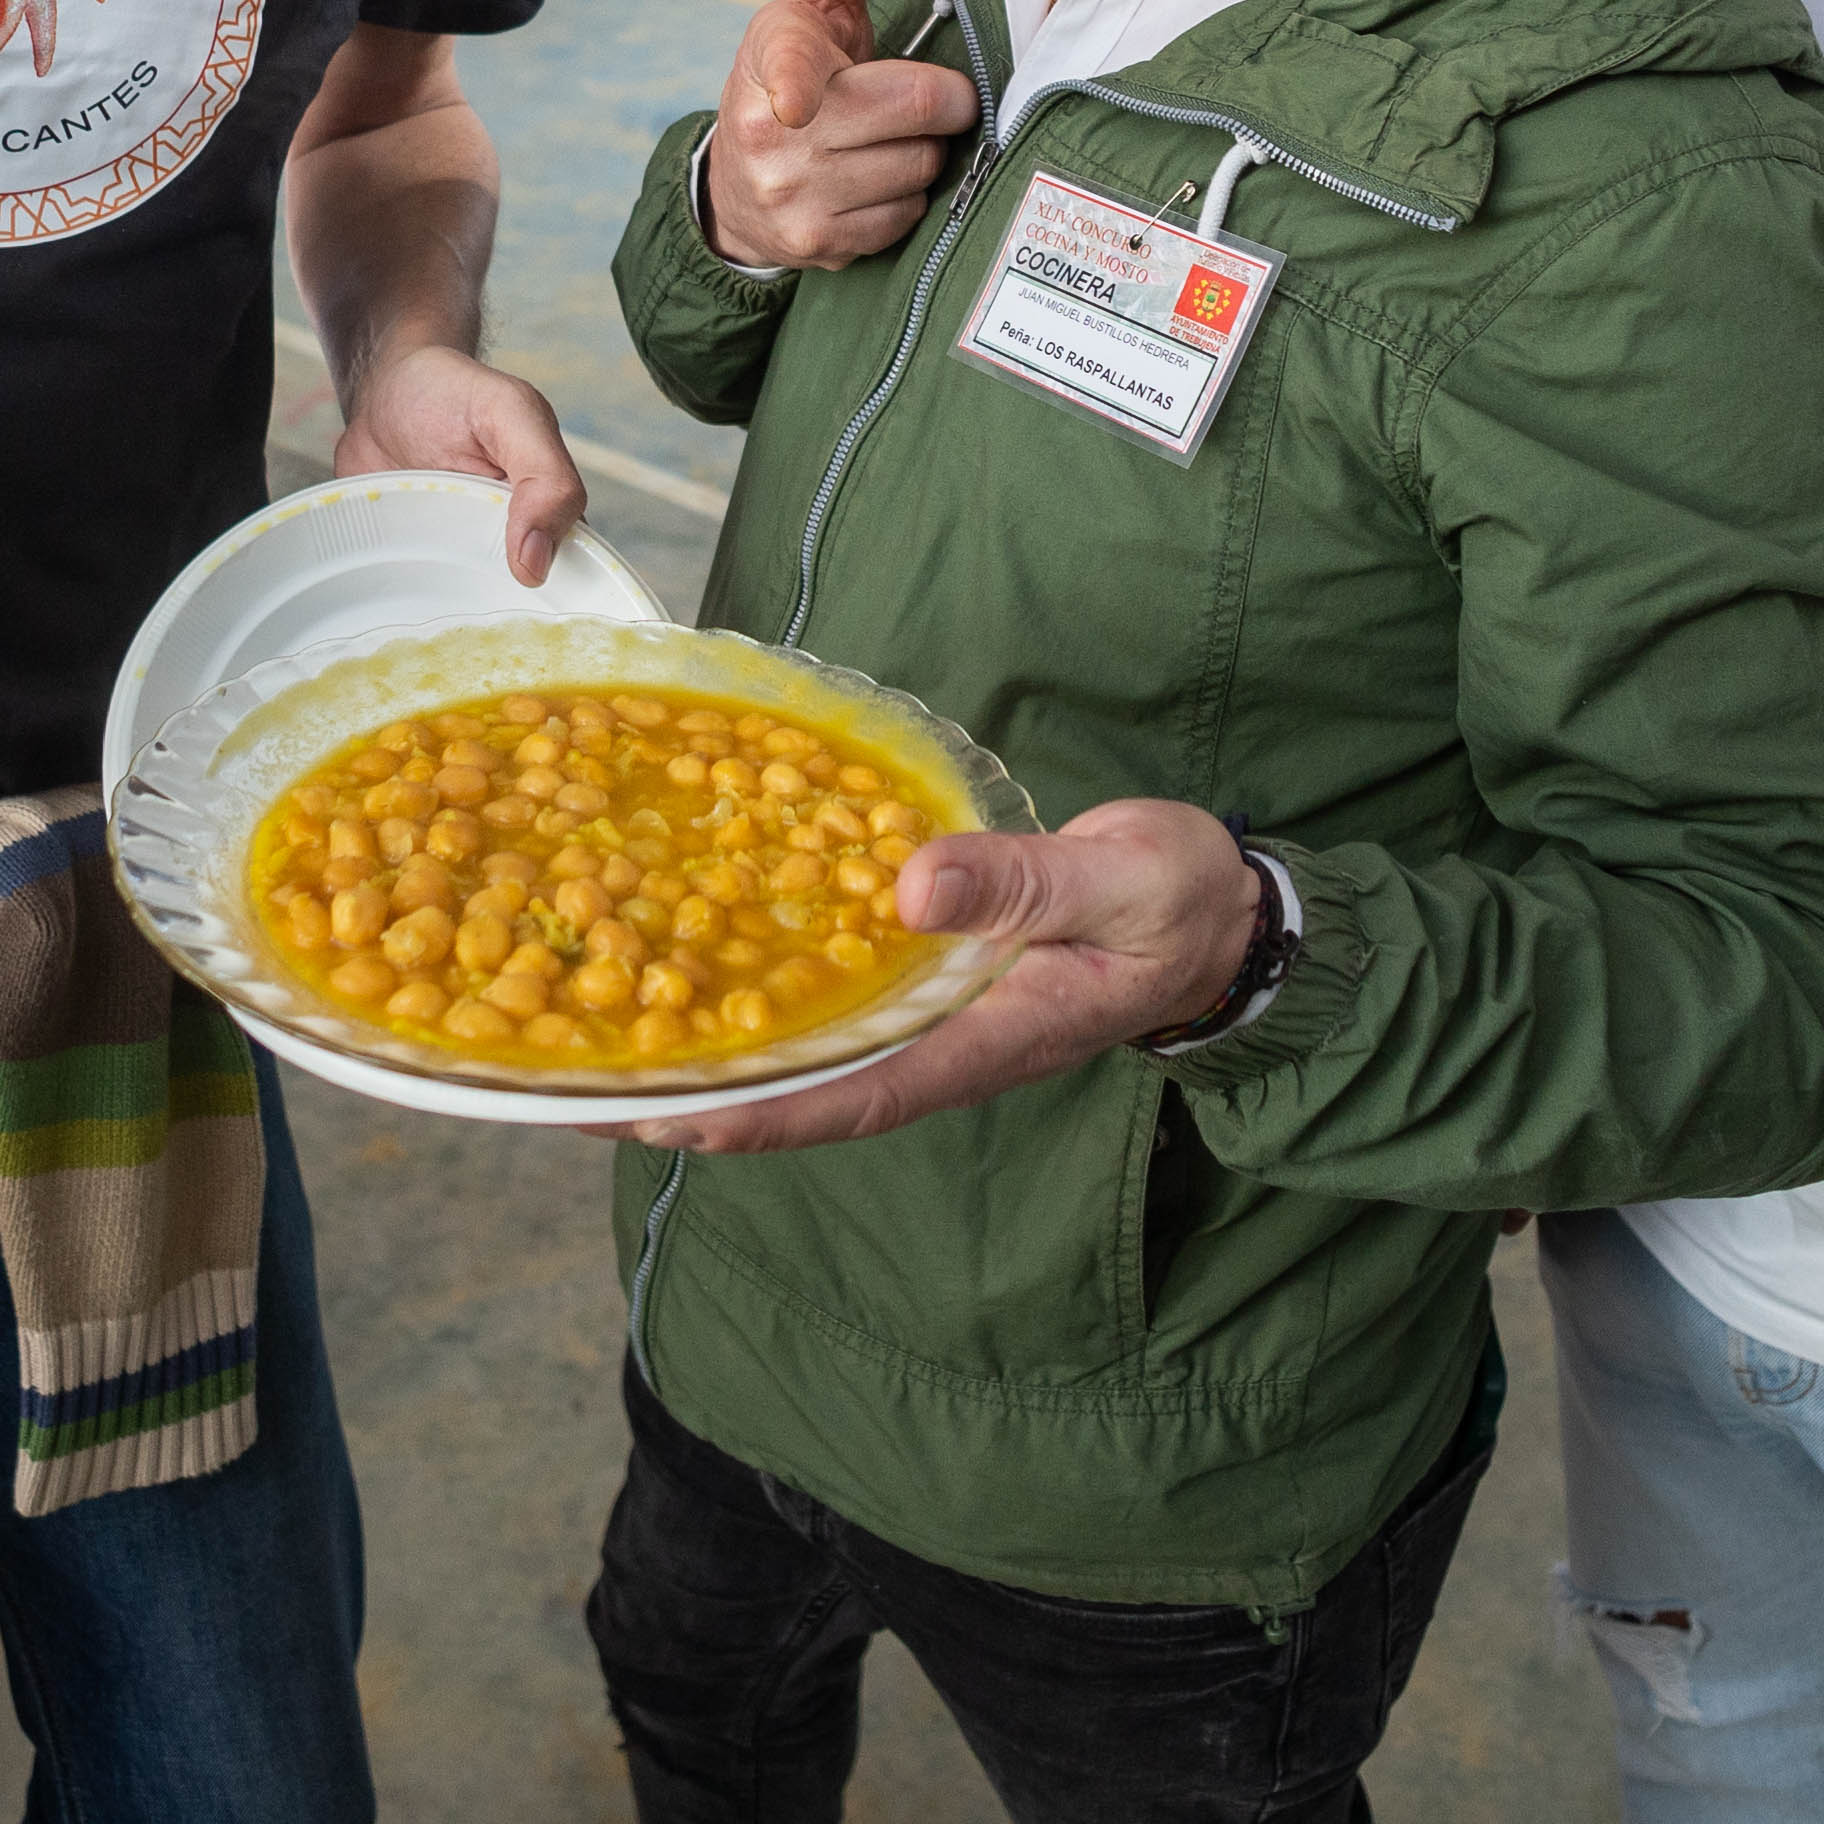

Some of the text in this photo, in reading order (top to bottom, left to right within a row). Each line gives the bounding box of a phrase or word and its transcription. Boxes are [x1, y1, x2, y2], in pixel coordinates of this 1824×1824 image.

[1034, 201, 1070, 225] XLIV
[1015, 246, 1117, 304] COCINERA
[1025, 222, 1149, 284] COCINA Y MOSTO
[1018, 287, 1190, 371] JUAN MIGUEL BUSTILLOS HEDRERA
[1168, 326, 1221, 354] DE TREBUJENA
[1170, 315, 1229, 345] AYUNTAMIENTO
[999, 320, 1174, 411] Peña: LOS RASPALLANTAS
